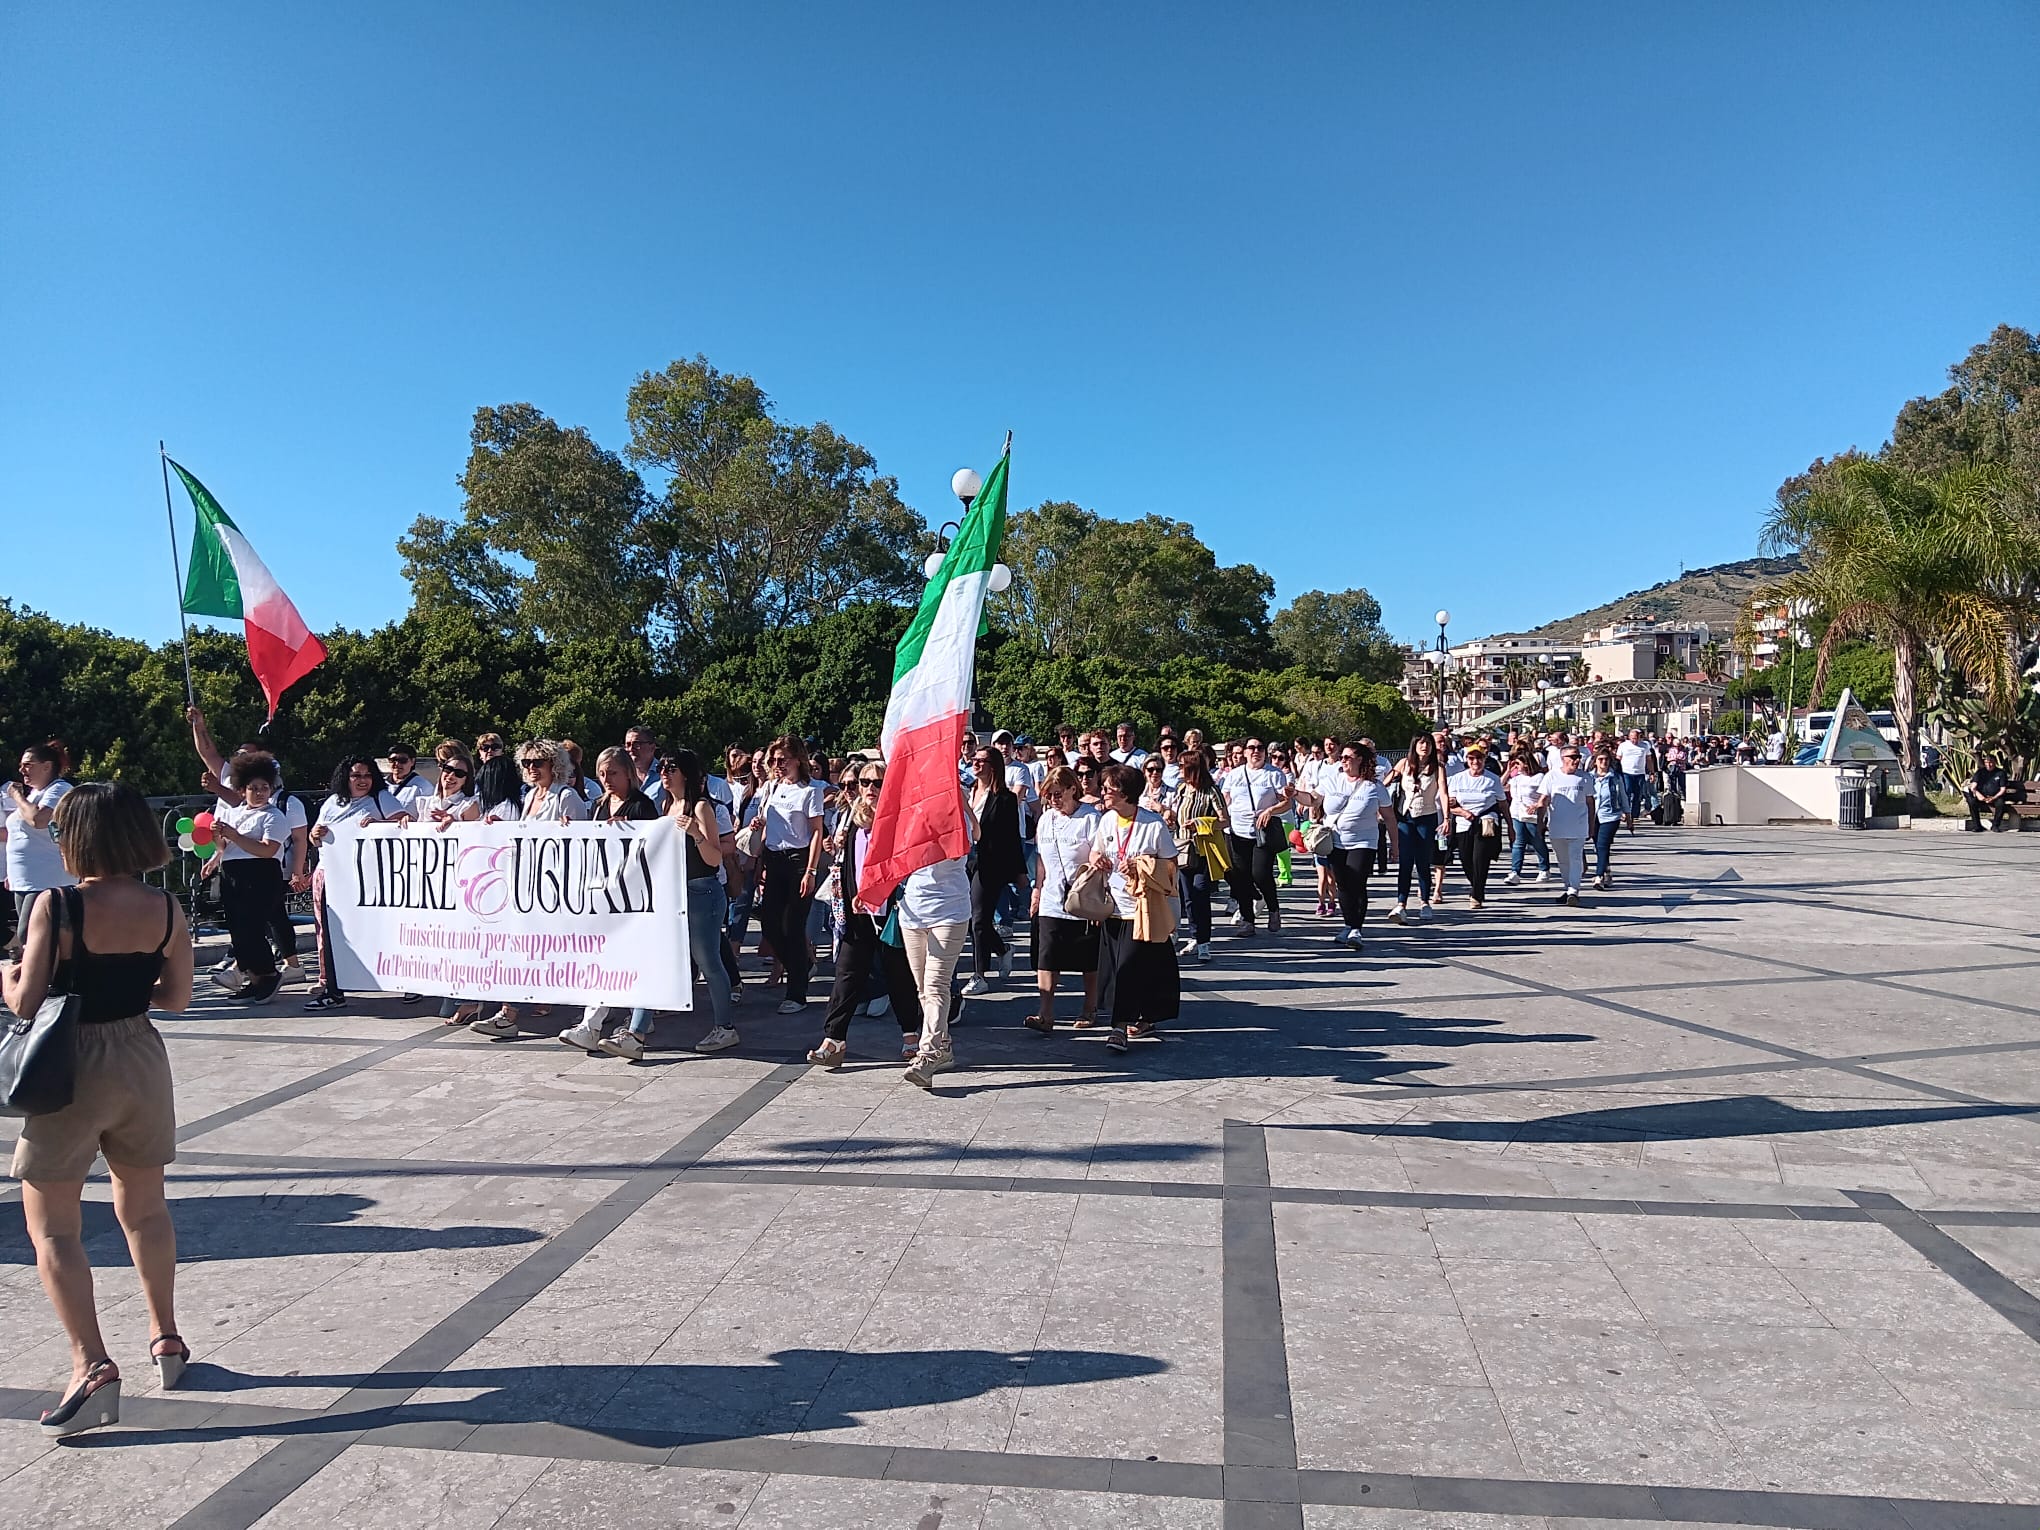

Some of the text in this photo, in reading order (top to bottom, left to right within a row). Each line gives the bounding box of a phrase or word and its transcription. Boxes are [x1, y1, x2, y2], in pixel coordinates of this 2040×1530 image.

[355, 838, 459, 910] LIBERE
[511, 838, 655, 915] UGUALI
[399, 922, 446, 949] Unisciti
[459, 925, 481, 951] noi
[480, 931, 508, 959] per
[509, 931, 606, 961] supportare
[376, 951, 391, 975] la
[545, 961, 585, 988] delle
[584, 963, 638, 991] Donne
